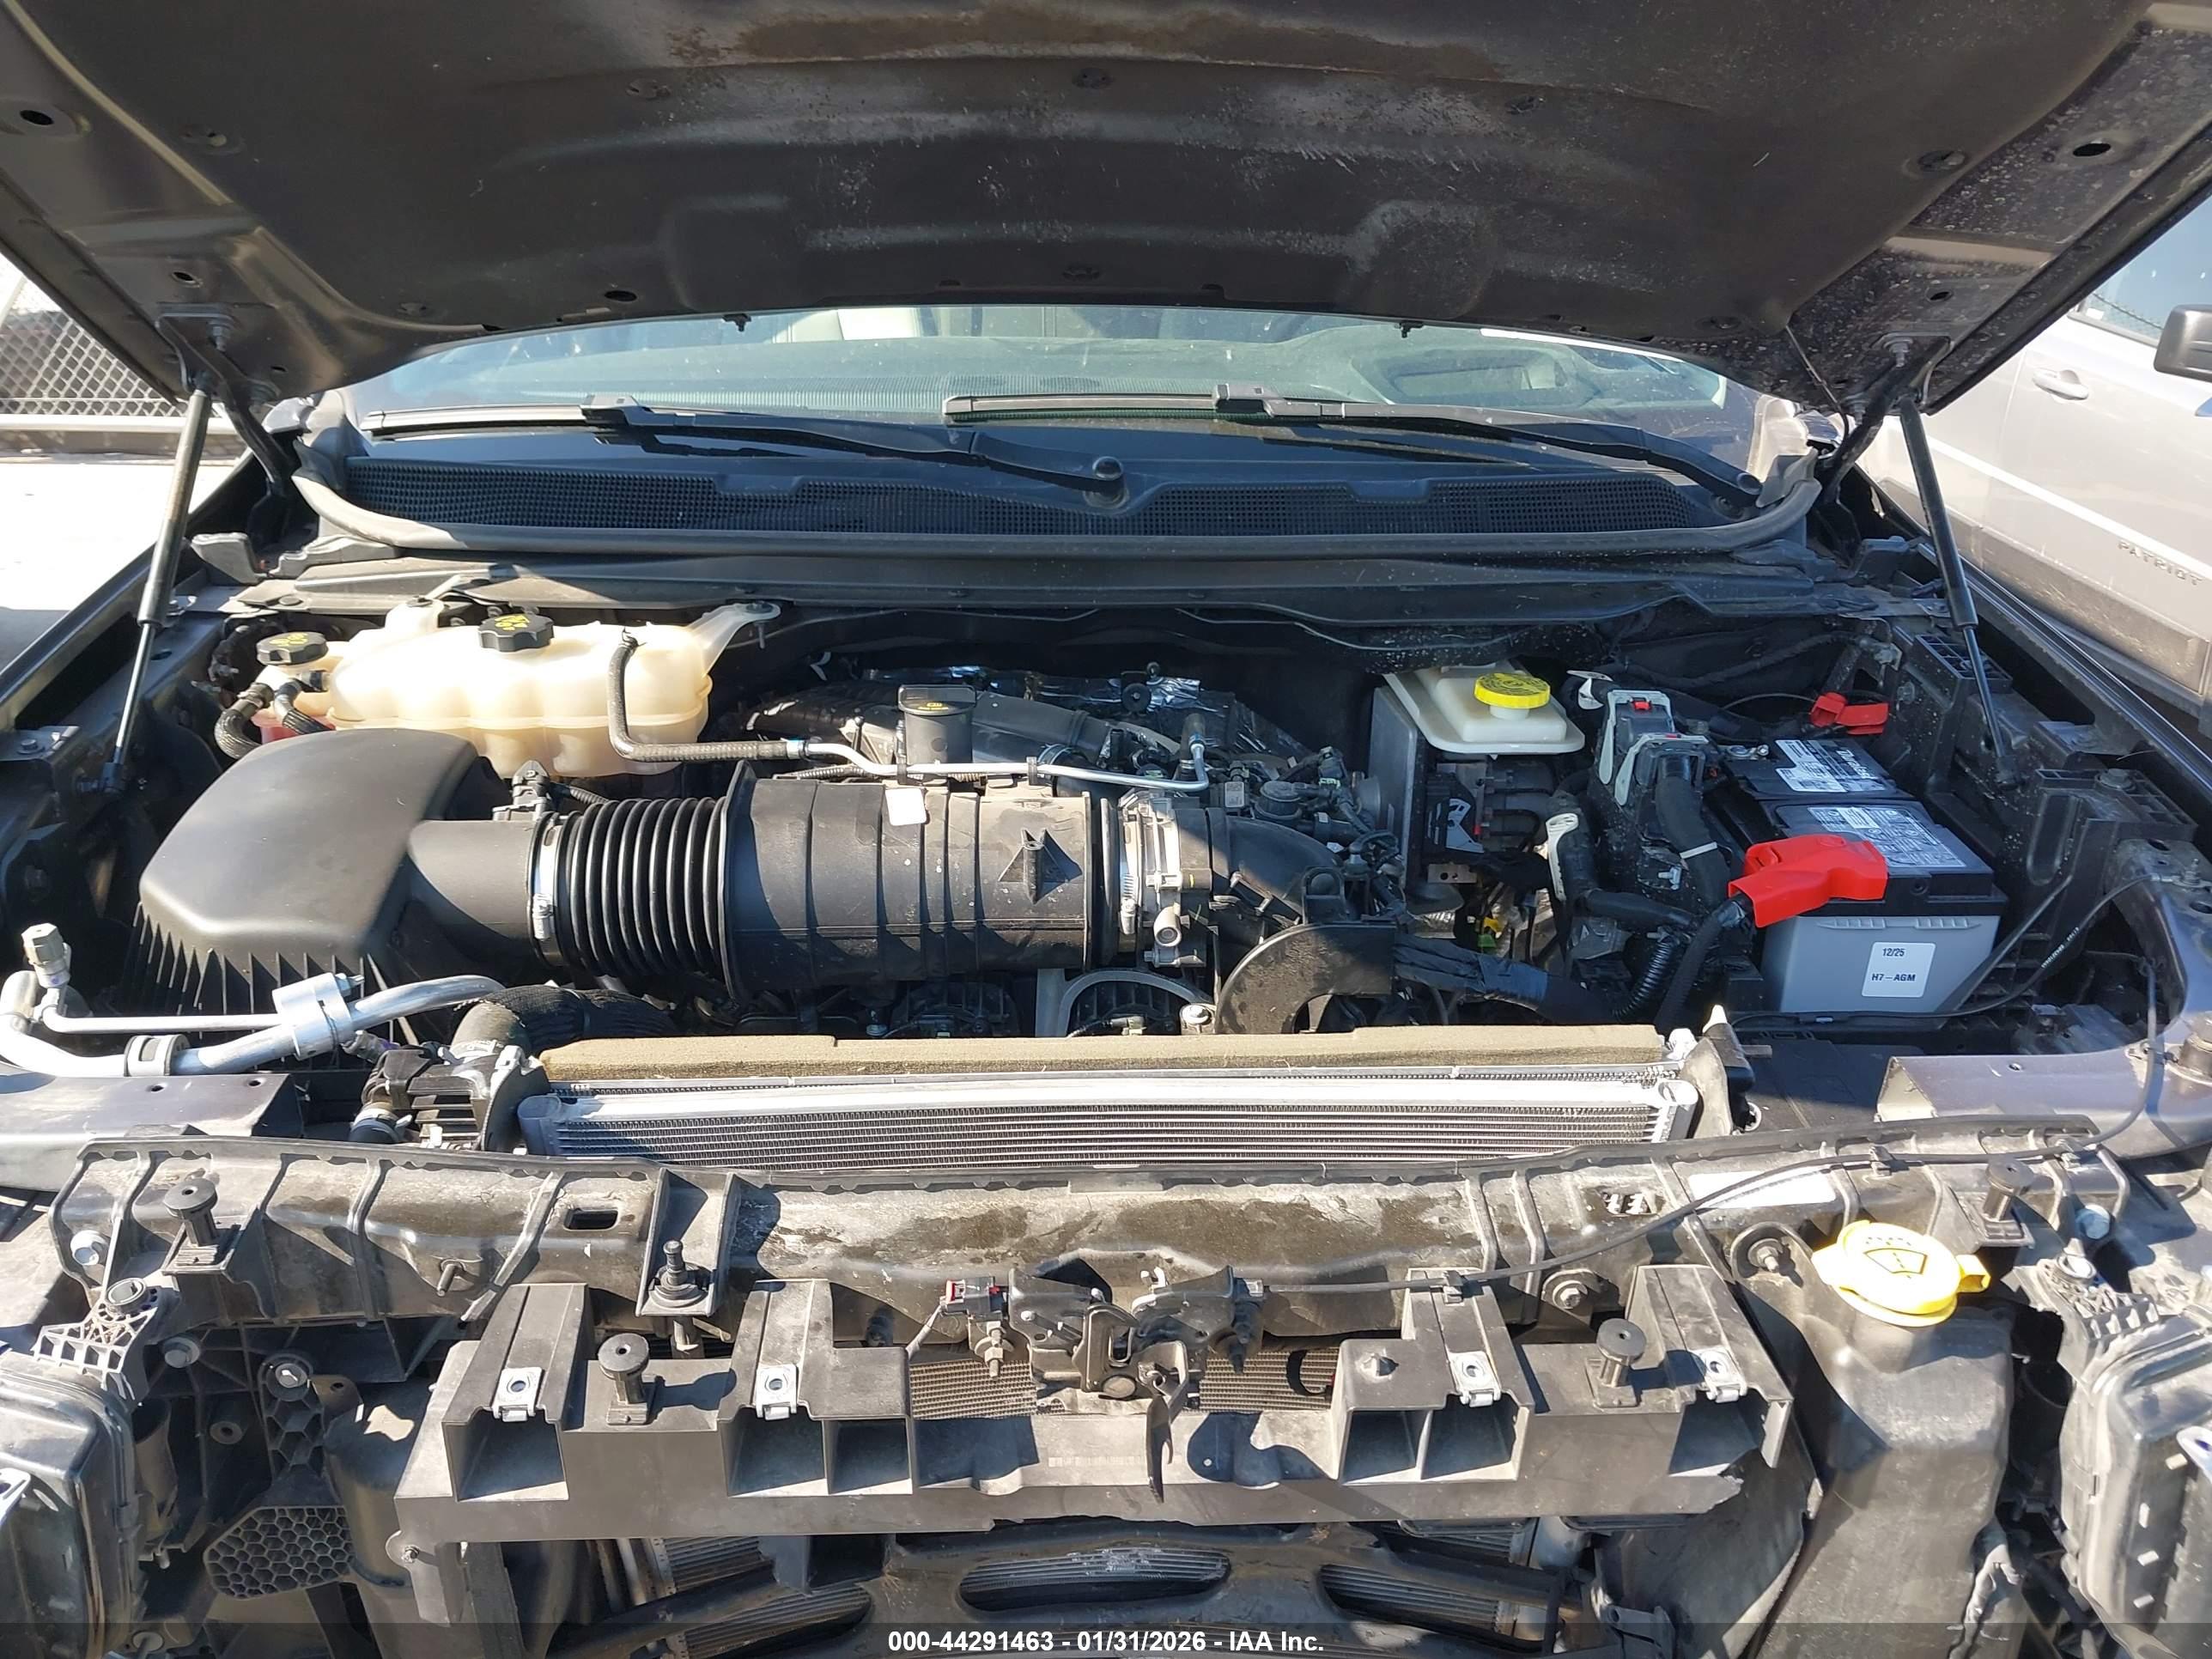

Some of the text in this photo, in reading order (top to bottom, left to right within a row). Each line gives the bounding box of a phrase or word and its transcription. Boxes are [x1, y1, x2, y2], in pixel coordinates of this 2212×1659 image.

[2118, 540, 2203, 586] PATRIOT
[1835, 749, 1879, 779] Duralast
[1882, 948, 1905, 957] 12/25
